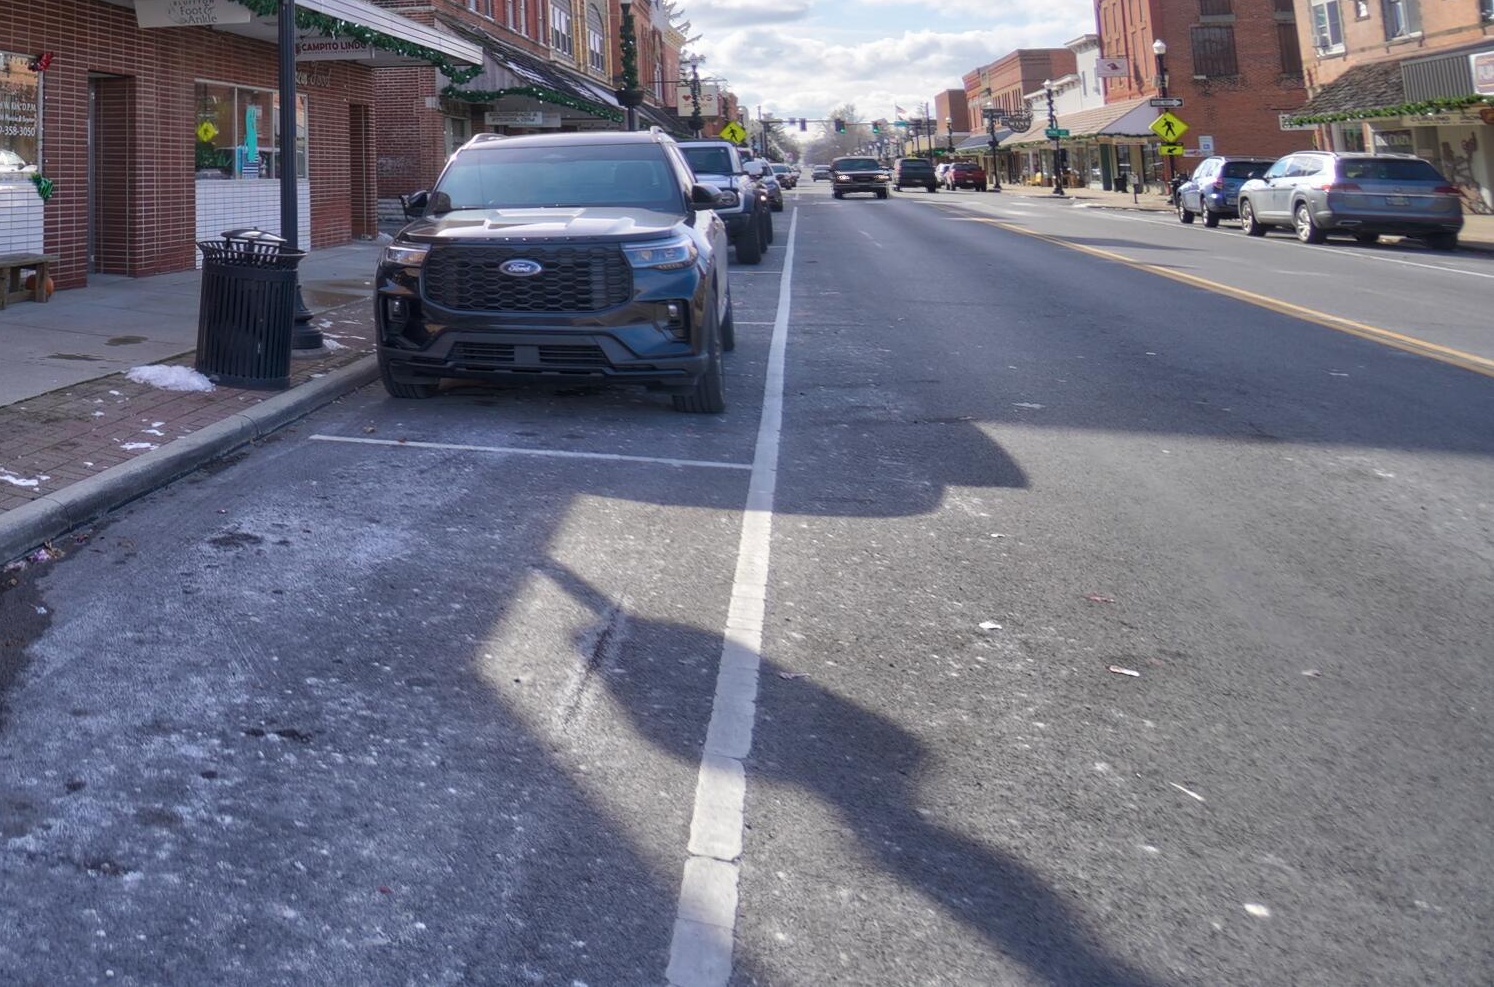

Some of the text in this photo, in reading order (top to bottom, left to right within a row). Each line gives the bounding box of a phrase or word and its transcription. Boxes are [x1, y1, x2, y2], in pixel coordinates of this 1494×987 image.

[180, 6, 203, 16] Foot
[188, 14, 218, 24] Ankle
[301, 42, 339, 52] CAMPITO
[340, 41, 367, 50] LINDO
